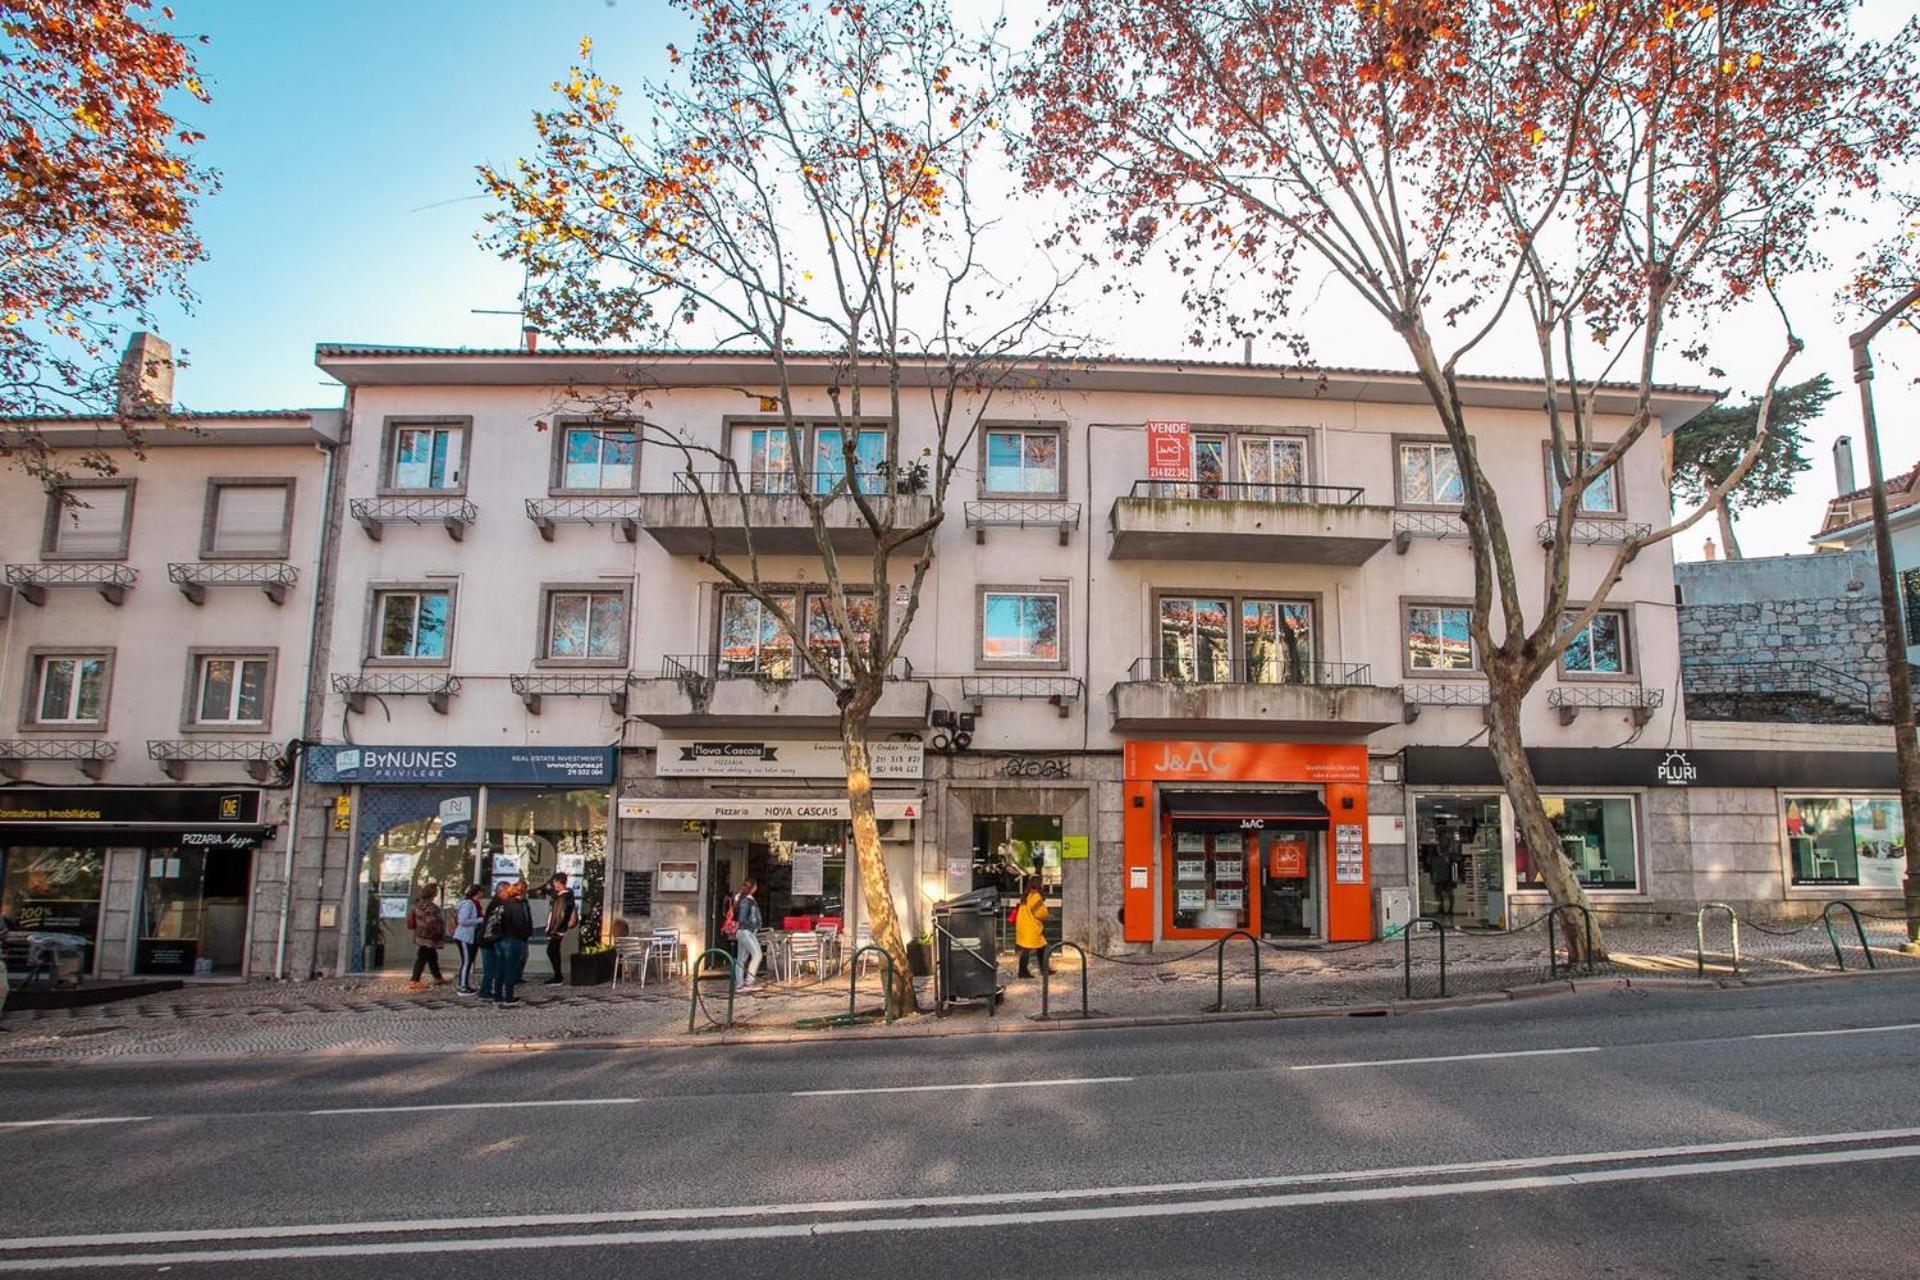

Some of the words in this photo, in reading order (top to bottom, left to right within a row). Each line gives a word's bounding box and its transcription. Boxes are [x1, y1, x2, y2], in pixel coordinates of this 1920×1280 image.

[1150, 423, 1188, 433] VENDE
[695, 744, 721, 755] Nova
[724, 744, 761, 756] Cascais
[364, 752, 457, 767] ByNUNES
[1154, 744, 1231, 773] J&AC
[1658, 766, 1697, 779] PLURI
[0, 809, 48, 818] onsultores
[715, 807, 748, 815] Pizzaria
[765, 807, 792, 815] NOVA
[797, 807, 838, 816] CASCAIS
[1240, 819, 1265, 829] J&AC
[182, 834, 222, 844] PIZZARIA
